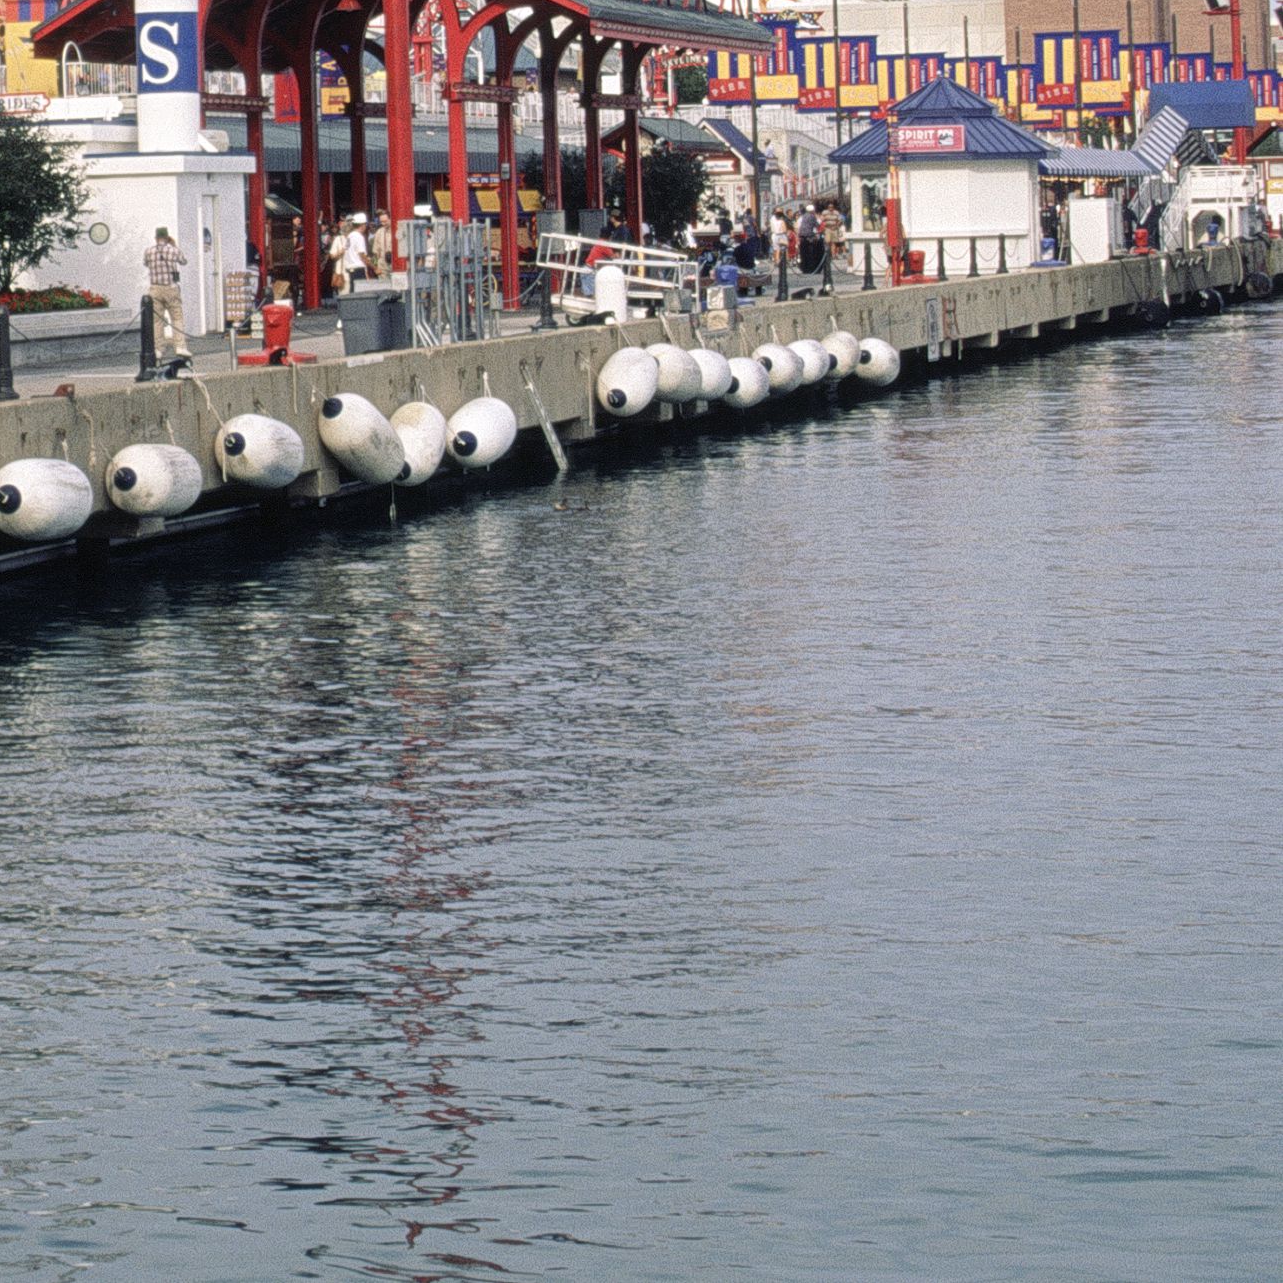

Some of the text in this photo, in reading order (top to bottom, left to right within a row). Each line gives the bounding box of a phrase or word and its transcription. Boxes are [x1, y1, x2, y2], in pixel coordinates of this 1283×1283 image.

[139, 20, 179, 85] S
[711, 80, 746, 97] PIER
[1038, 86, 1070, 102] PIER
[799, 90, 832, 105] PIER
[898, 129, 935, 141] SPIRIT
